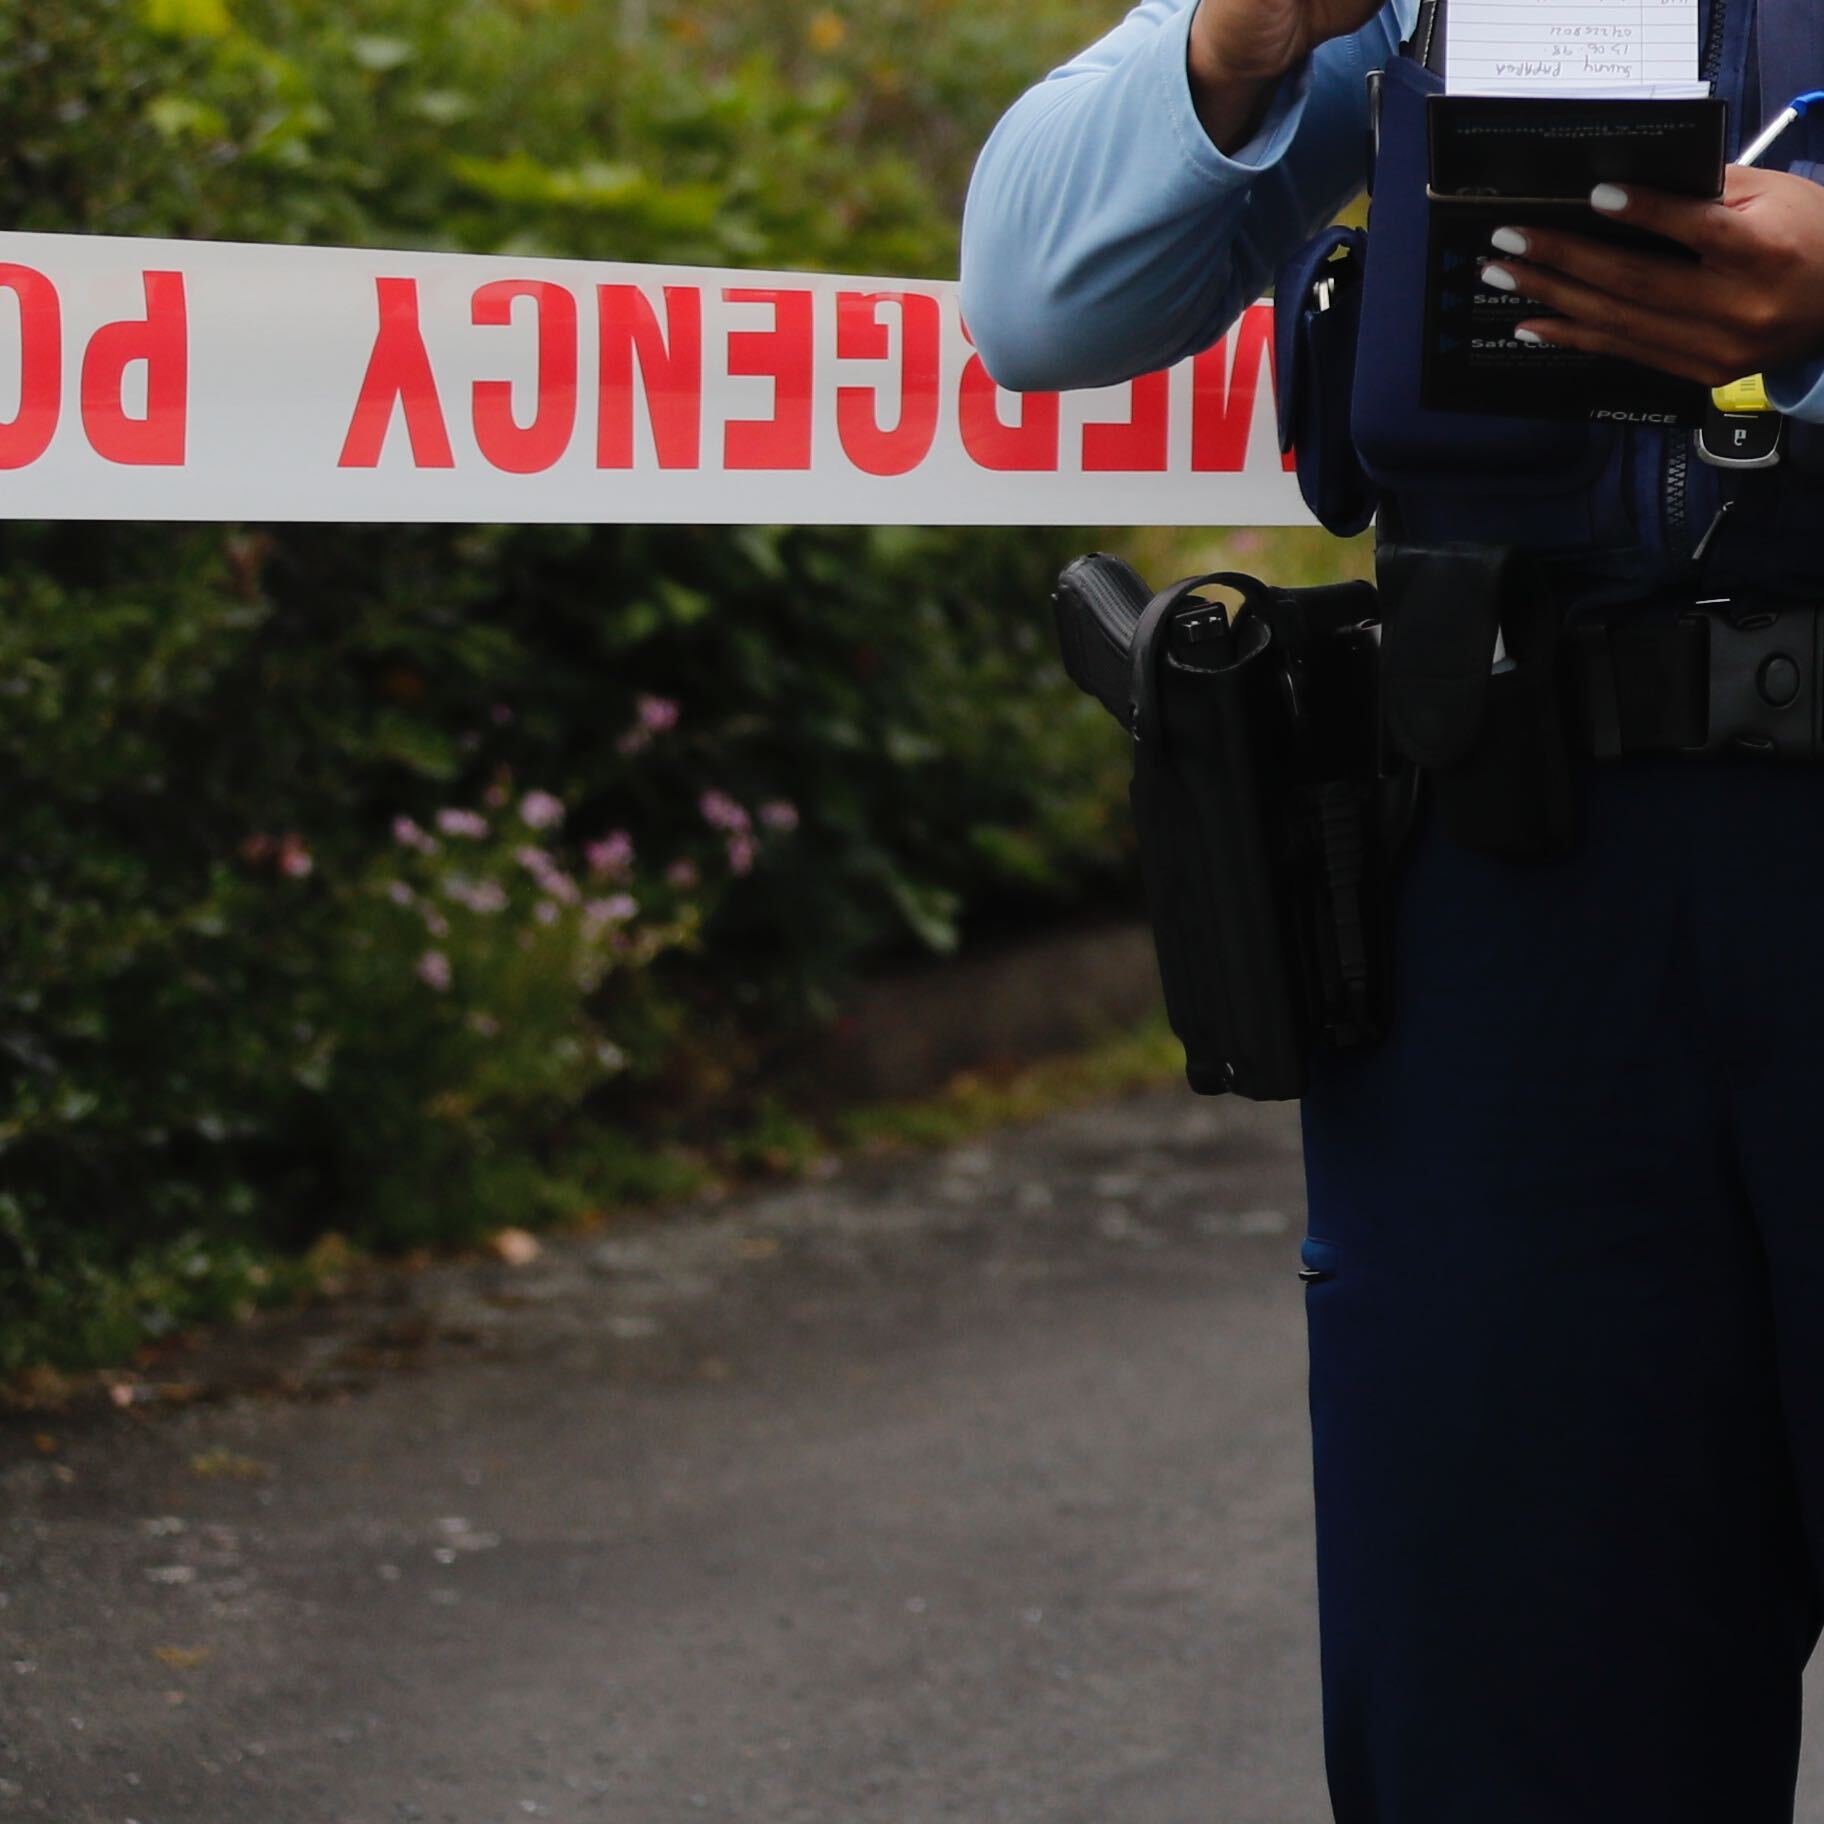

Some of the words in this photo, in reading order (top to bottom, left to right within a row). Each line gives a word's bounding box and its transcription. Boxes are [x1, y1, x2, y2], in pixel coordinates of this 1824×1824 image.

[1473, 294, 1520, 305] Safe
[1471, 338, 1519, 349] Safe
[340, 277, 1294, 476] MERGENCY
[1596, 410, 1678, 424] POLICE
